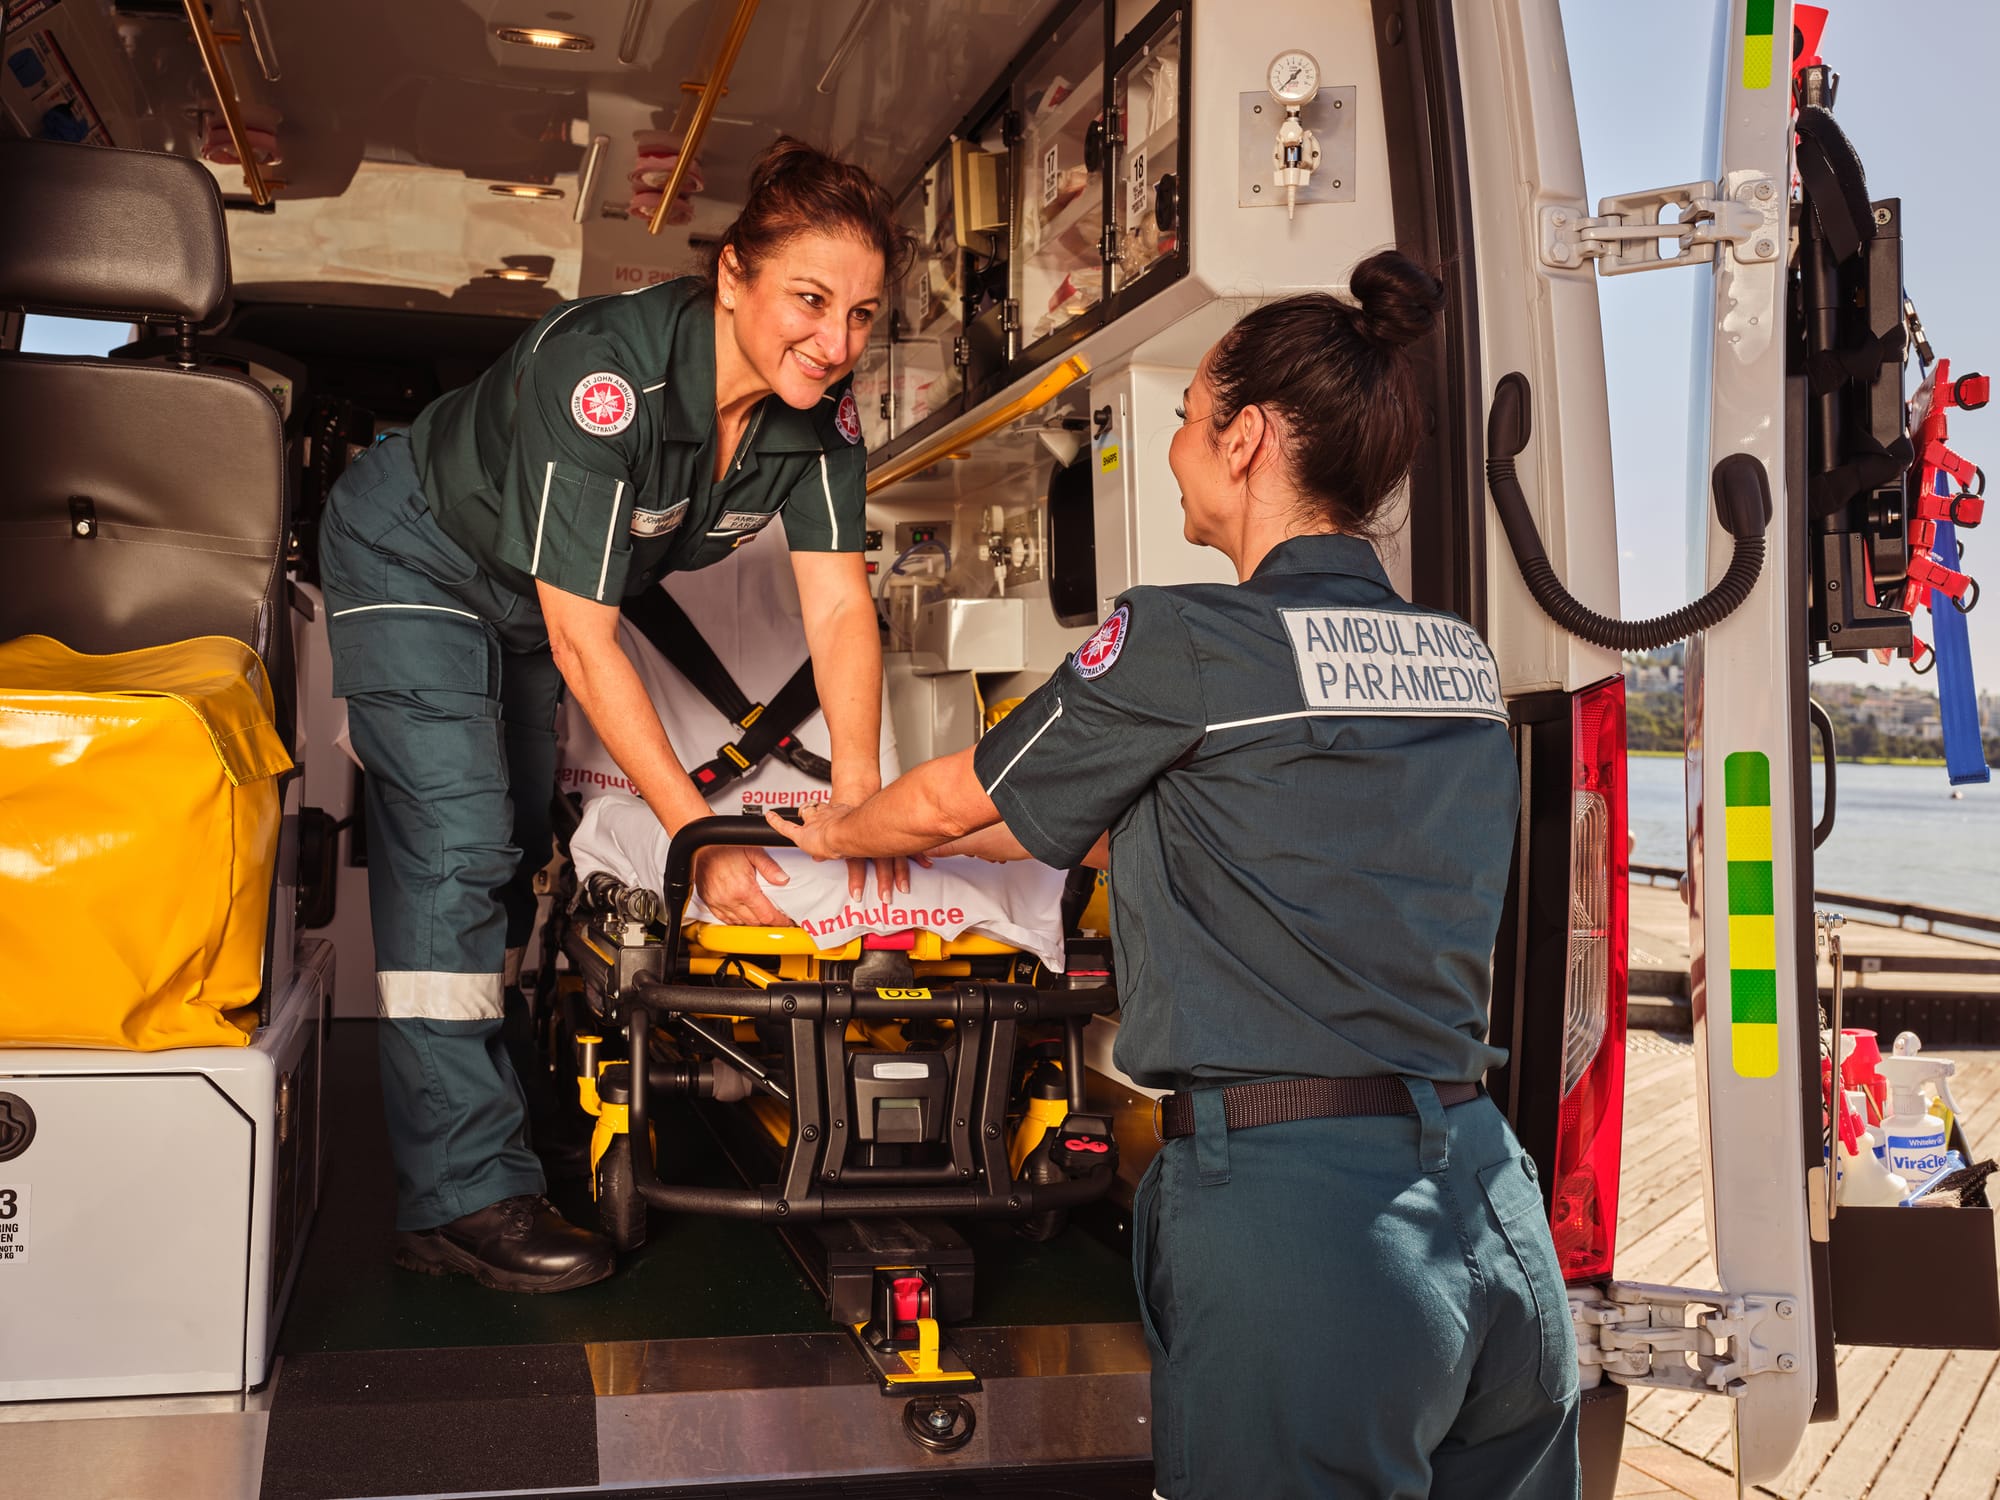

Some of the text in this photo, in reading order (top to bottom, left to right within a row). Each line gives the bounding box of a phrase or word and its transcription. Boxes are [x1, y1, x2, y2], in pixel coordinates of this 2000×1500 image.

[1047, 150, 1055, 174] 17
[1134, 154, 1144, 181] 18
[574, 396, 618, 433] WESTERN AUSTRALIA
[582, 380, 592, 390] ST
[614, 379, 633, 421] AMBULANCE
[632, 512, 643, 521] ST
[1306, 617, 1489, 662] AMBULANCE
[1316, 662, 1496, 705] PARAMEDIC
[801, 902, 964, 937] Ambulance
[4, 1252, 14, 1260] KG
